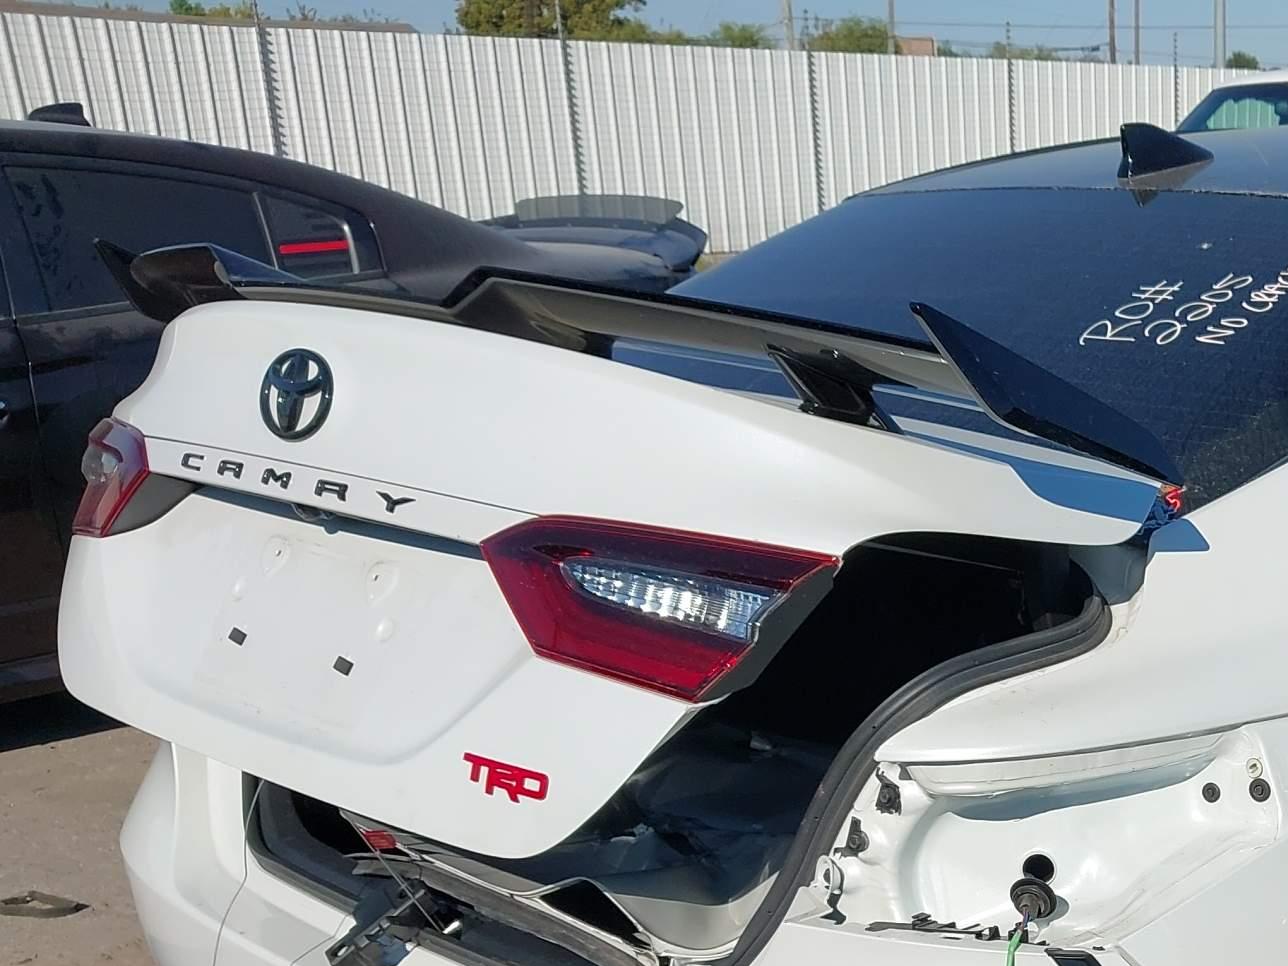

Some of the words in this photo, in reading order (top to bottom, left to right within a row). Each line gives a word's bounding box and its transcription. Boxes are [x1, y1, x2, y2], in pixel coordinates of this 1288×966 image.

[1195, 317, 1249, 345] NO
[180, 452, 417, 514] CAMRY
[462, 751, 550, 804] TRD
